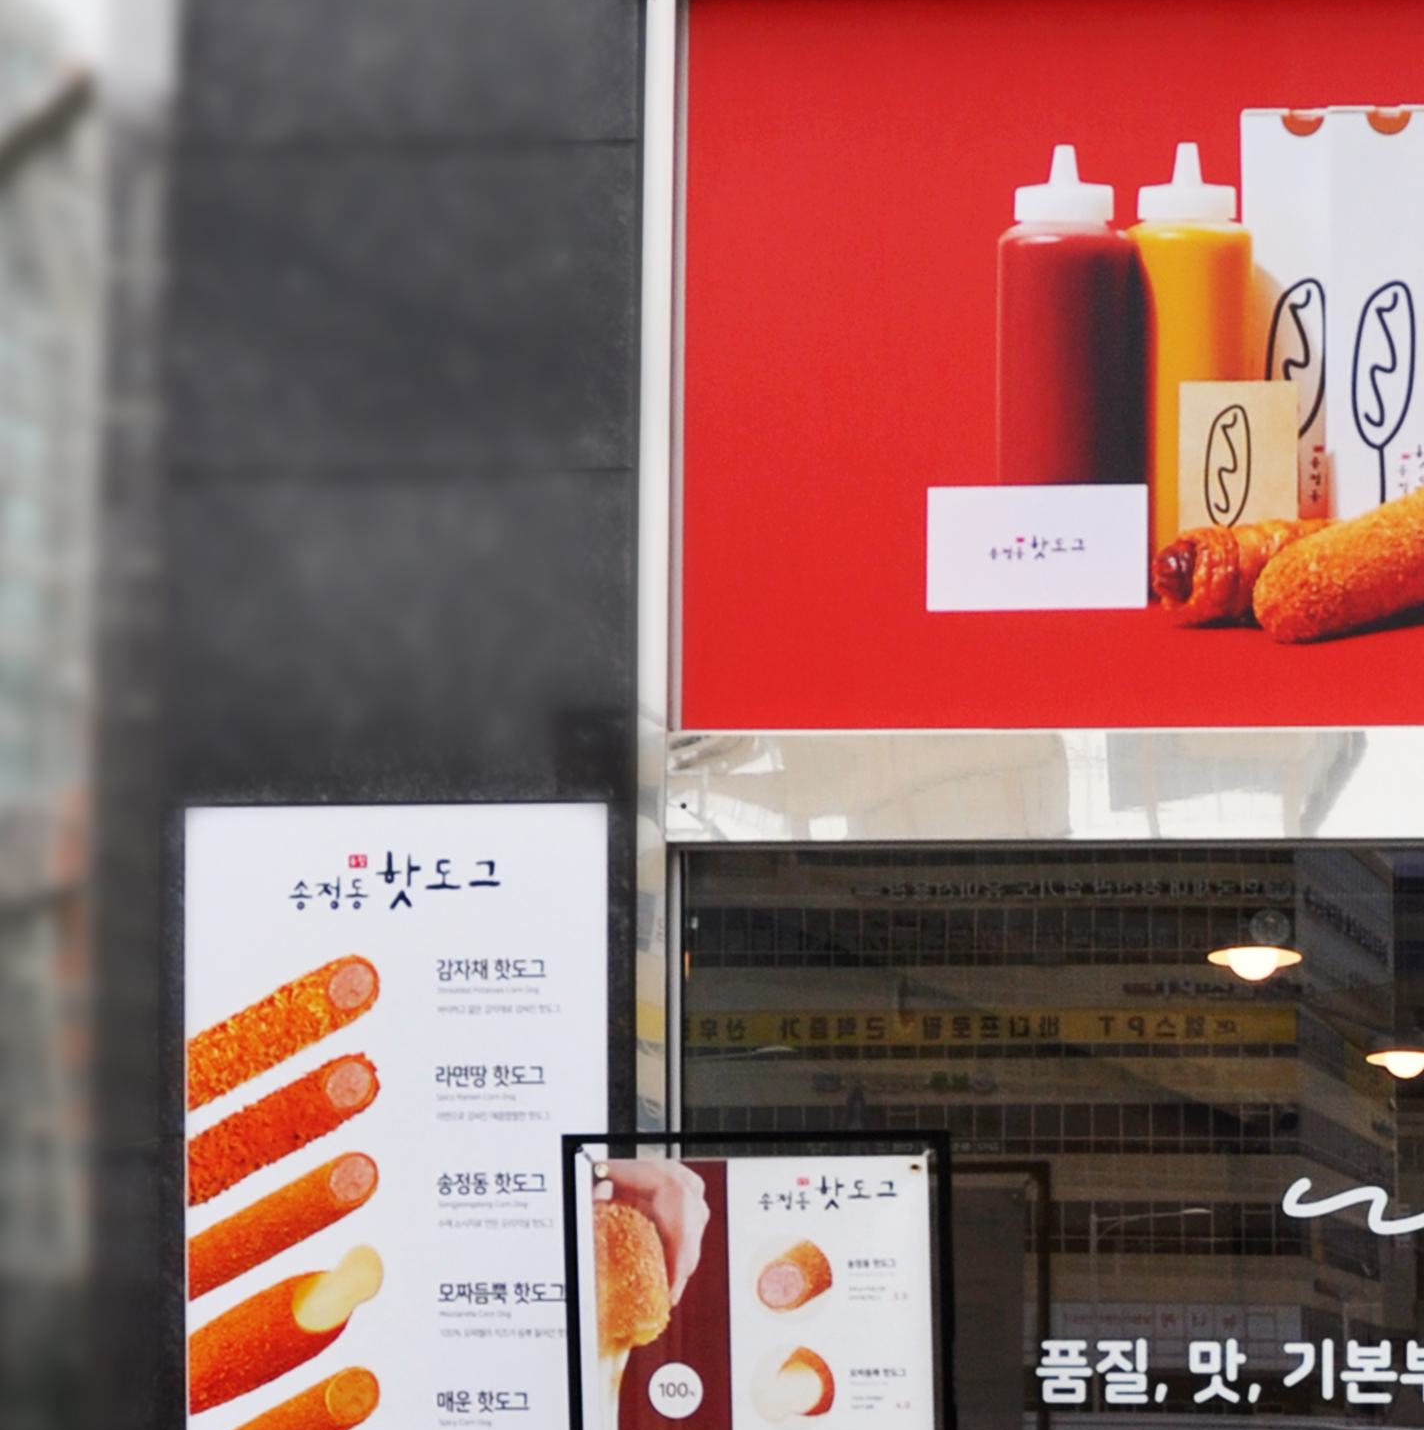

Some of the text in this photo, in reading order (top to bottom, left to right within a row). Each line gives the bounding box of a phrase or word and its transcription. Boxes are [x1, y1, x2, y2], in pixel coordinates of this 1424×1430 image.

[289, 850, 501, 910] 송정동 핫도그
[437, 959, 546, 981] 감자채 핫도그
[435, 1065, 545, 1088] 라면땅 핫도그
[437, 1172, 546, 1195] 송정동 핫도그
[759, 1175, 897, 1210] 송정동 핫도그
[438, 1282, 566, 1304] 모짜듬뿍 핫도그
[1036, 1337, 1168, 1404] 품질,
[1188, 1337, 1262, 1404] 맛,
[437, 1390, 529, 1412] 매운 핫도그
